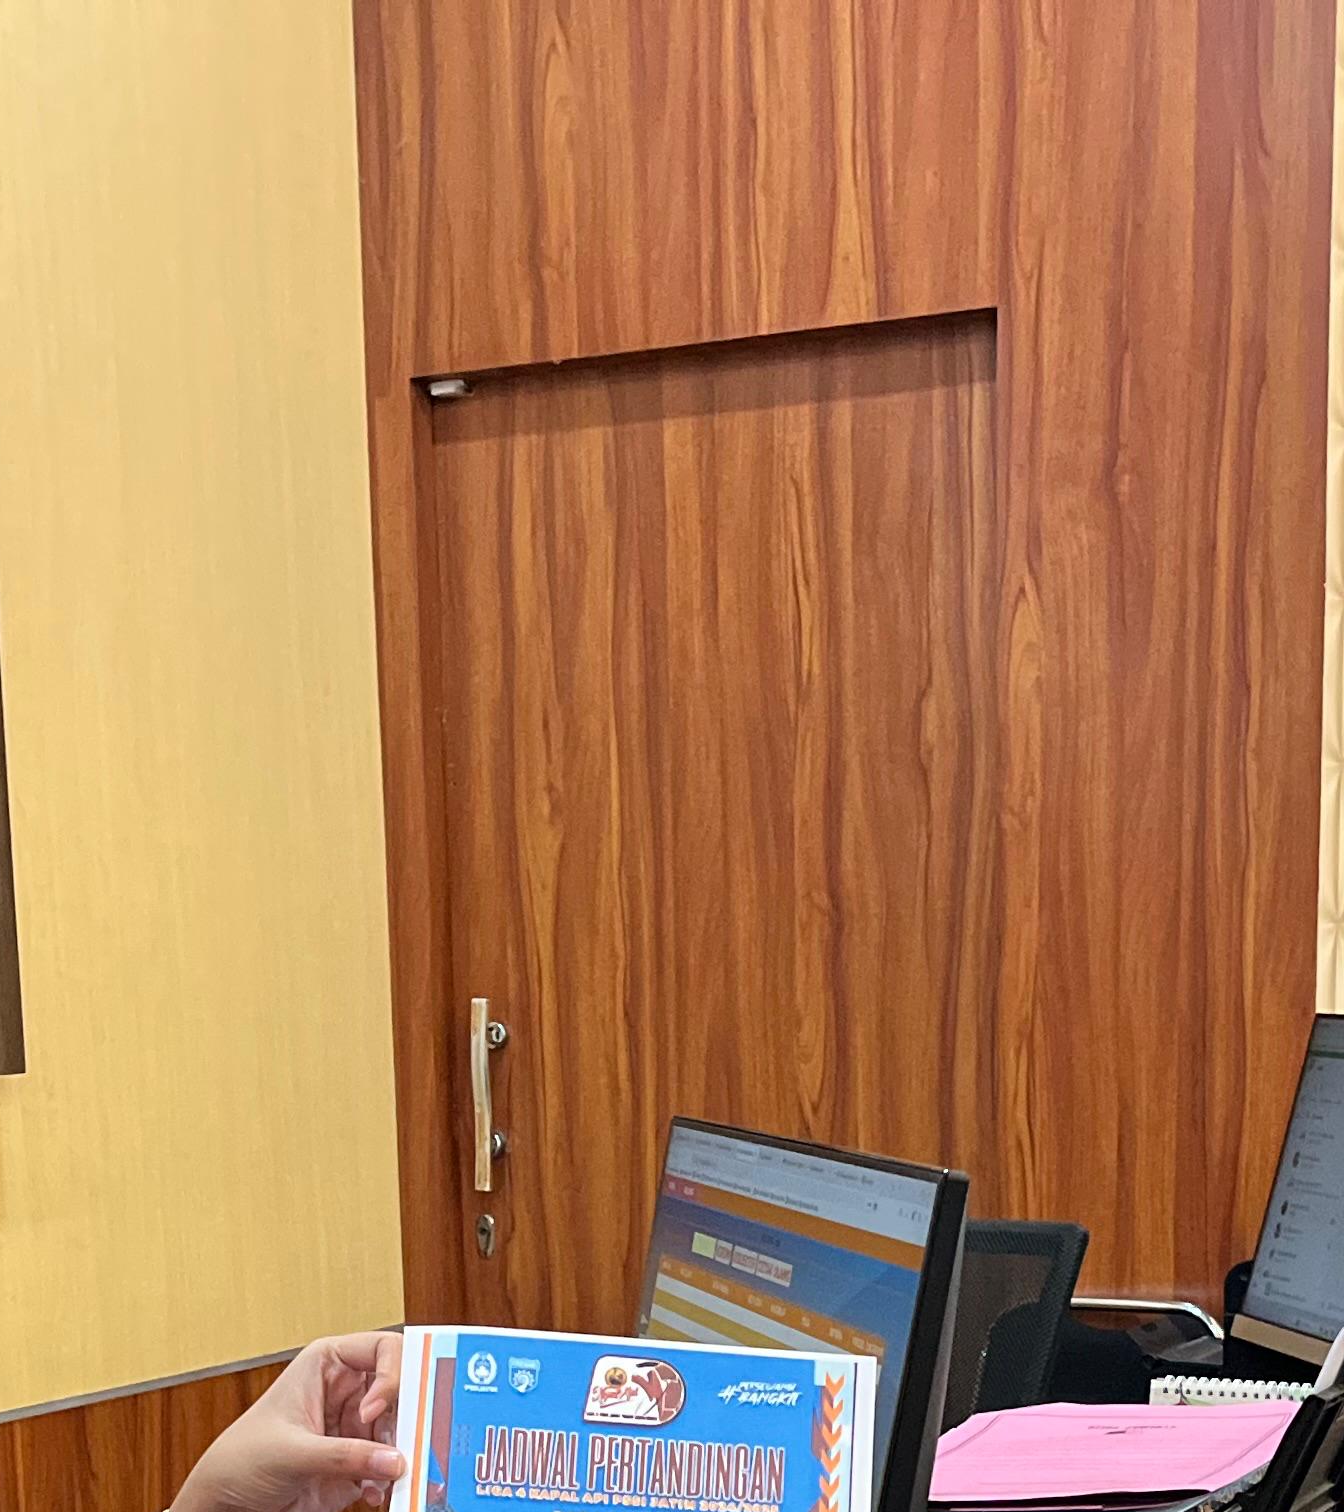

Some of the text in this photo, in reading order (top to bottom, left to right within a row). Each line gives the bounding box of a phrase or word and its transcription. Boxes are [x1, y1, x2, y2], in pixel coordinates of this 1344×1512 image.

[476, 1426, 786, 1503] JADWAL PERTANDINGAN
[476, 1484, 513, 1498] LIGA
